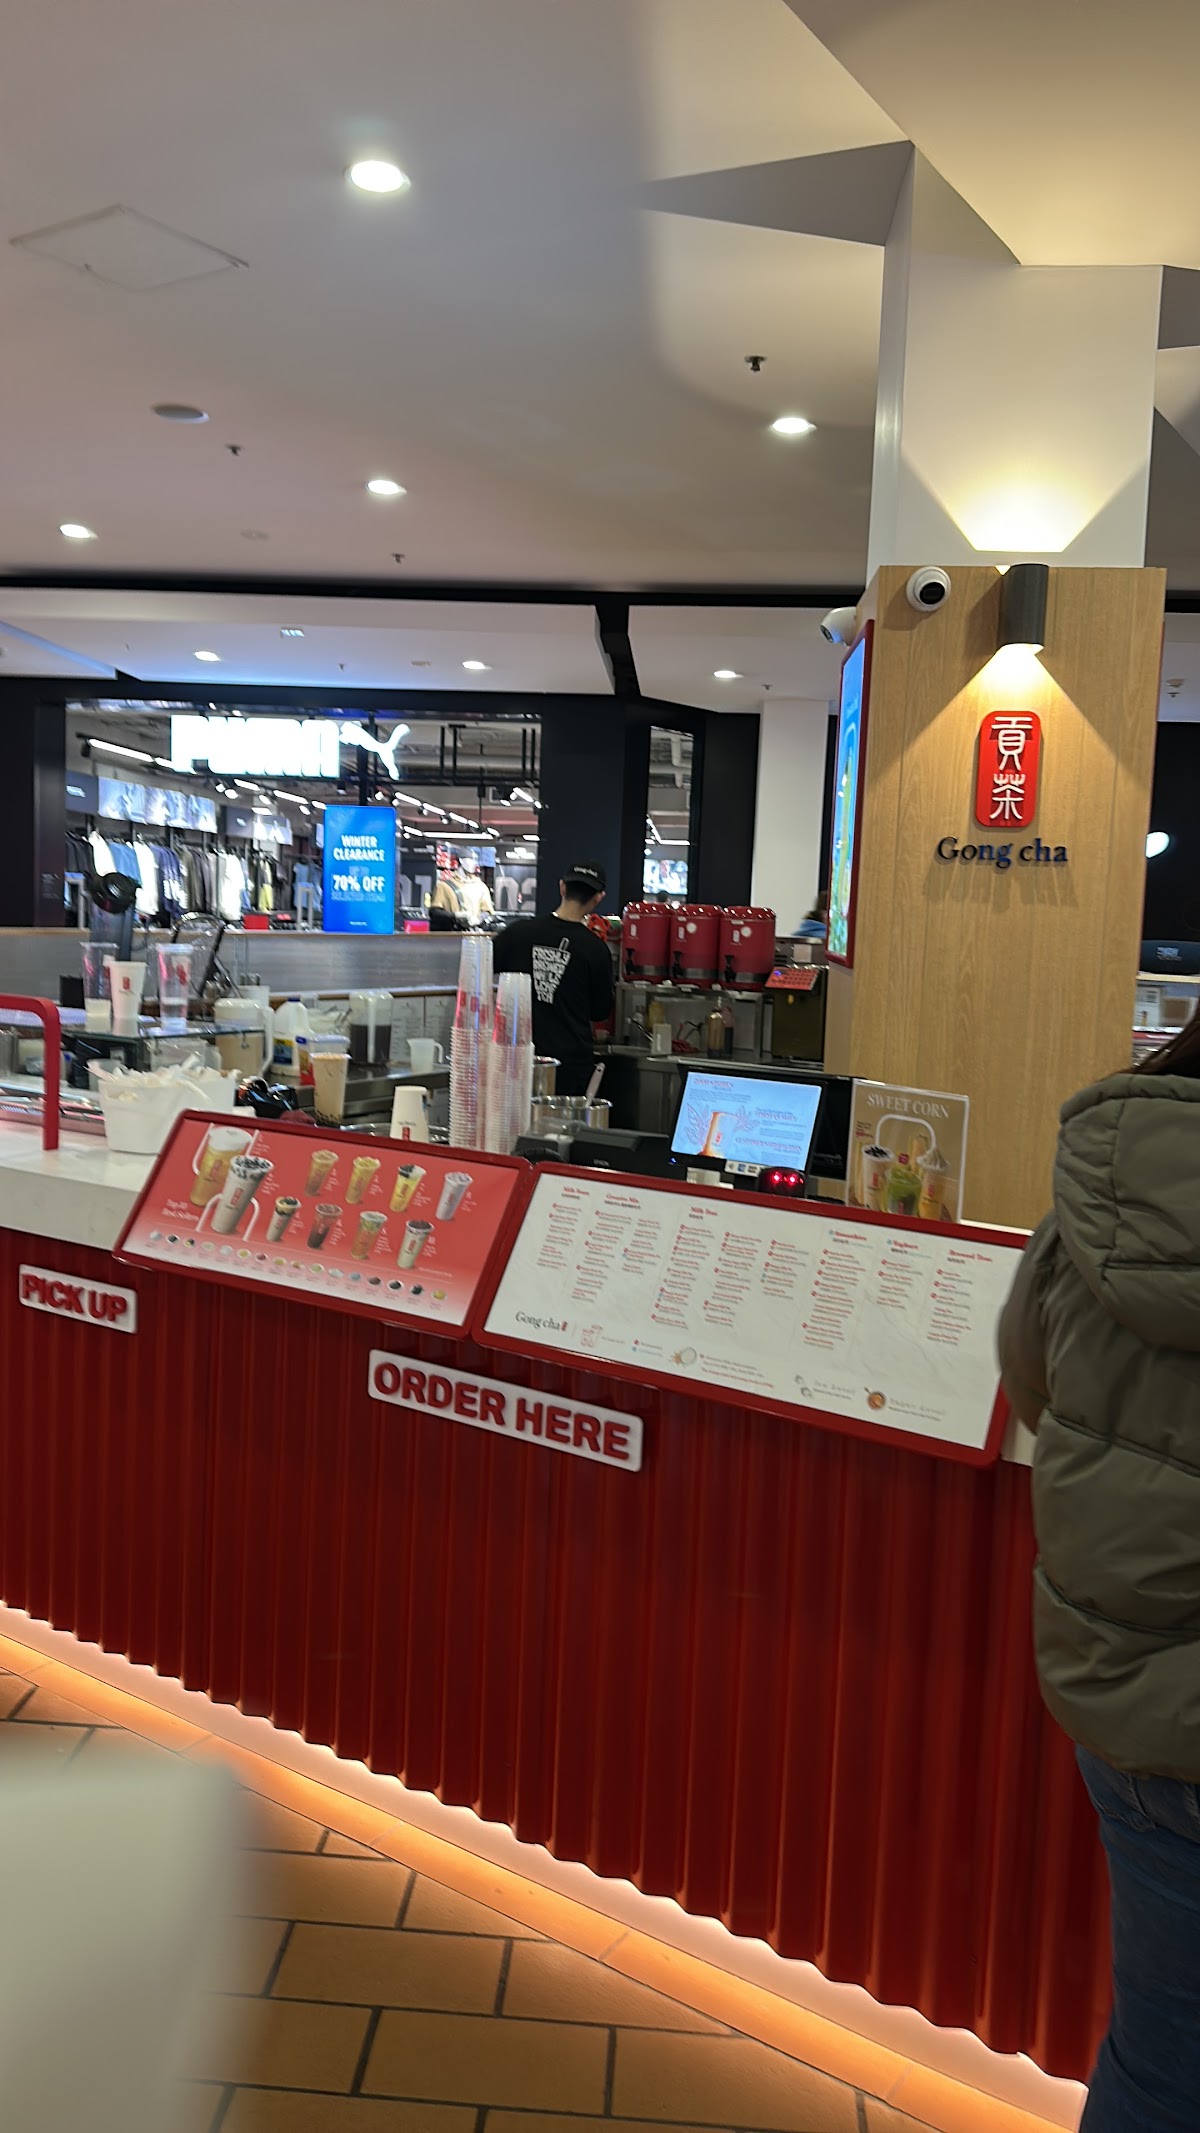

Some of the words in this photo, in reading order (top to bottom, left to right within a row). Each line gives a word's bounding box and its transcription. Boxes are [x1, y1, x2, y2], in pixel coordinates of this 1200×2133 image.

[989, 716, 1033, 820] 貢茶
[341, 834, 378, 848] WINTER
[937, 836, 1013, 869] Gong
[1019, 837, 1068, 862] cha
[333, 847, 385, 862] CLEARANCE
[333, 874, 361, 891] 70%
[362, 875, 385, 892] OFF
[867, 1093, 911, 1112] SWEET
[912, 1101, 949, 1119] CORN
[21, 1273, 84, 1315] PICK
[87, 1289, 127, 1322] UP
[515, 1310, 540, 1329] Gong
[542, 1318, 561, 1331] cha
[374, 1362, 506, 1426] ORDER
[515, 1397, 630, 1461] HERE
